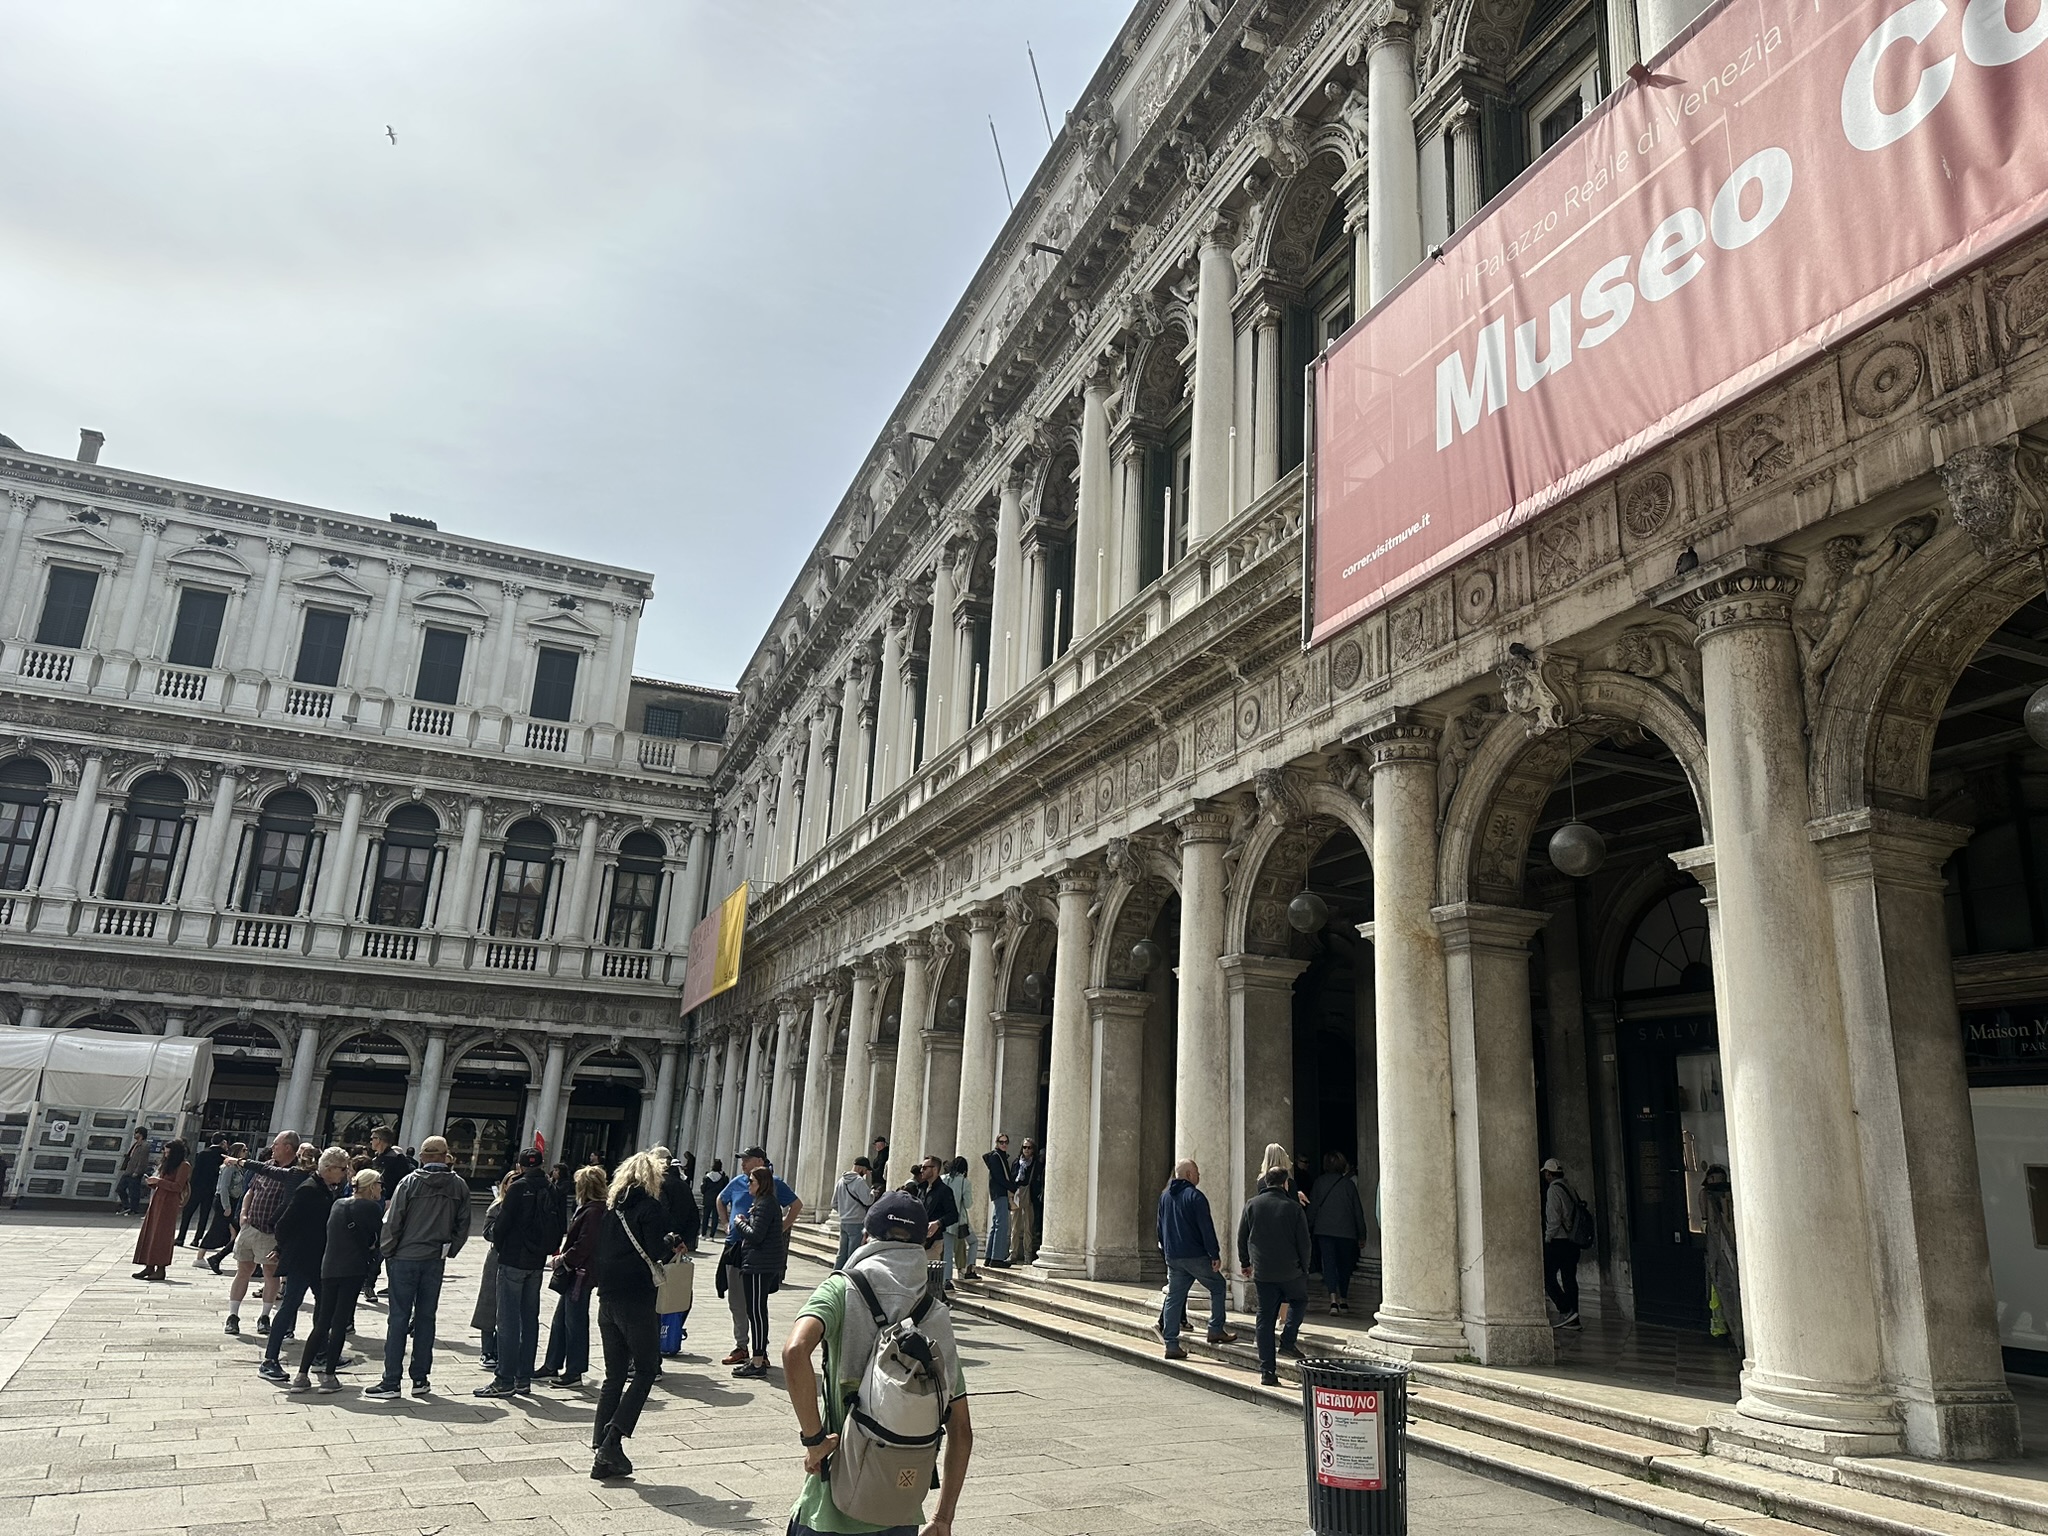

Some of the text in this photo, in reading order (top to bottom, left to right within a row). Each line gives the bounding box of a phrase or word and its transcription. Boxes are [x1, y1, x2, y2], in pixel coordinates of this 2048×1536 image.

[1459, 25, 1782, 300] Il Palazzo Reale di Venezia
[1436, 147, 1793, 452] Museo
[1342, 512, 1431, 579] correr.visitmuve.it
[1969, 1023, 2030, 1040] Maison
[1316, 1390, 1376, 1410] VIETATO/NO
